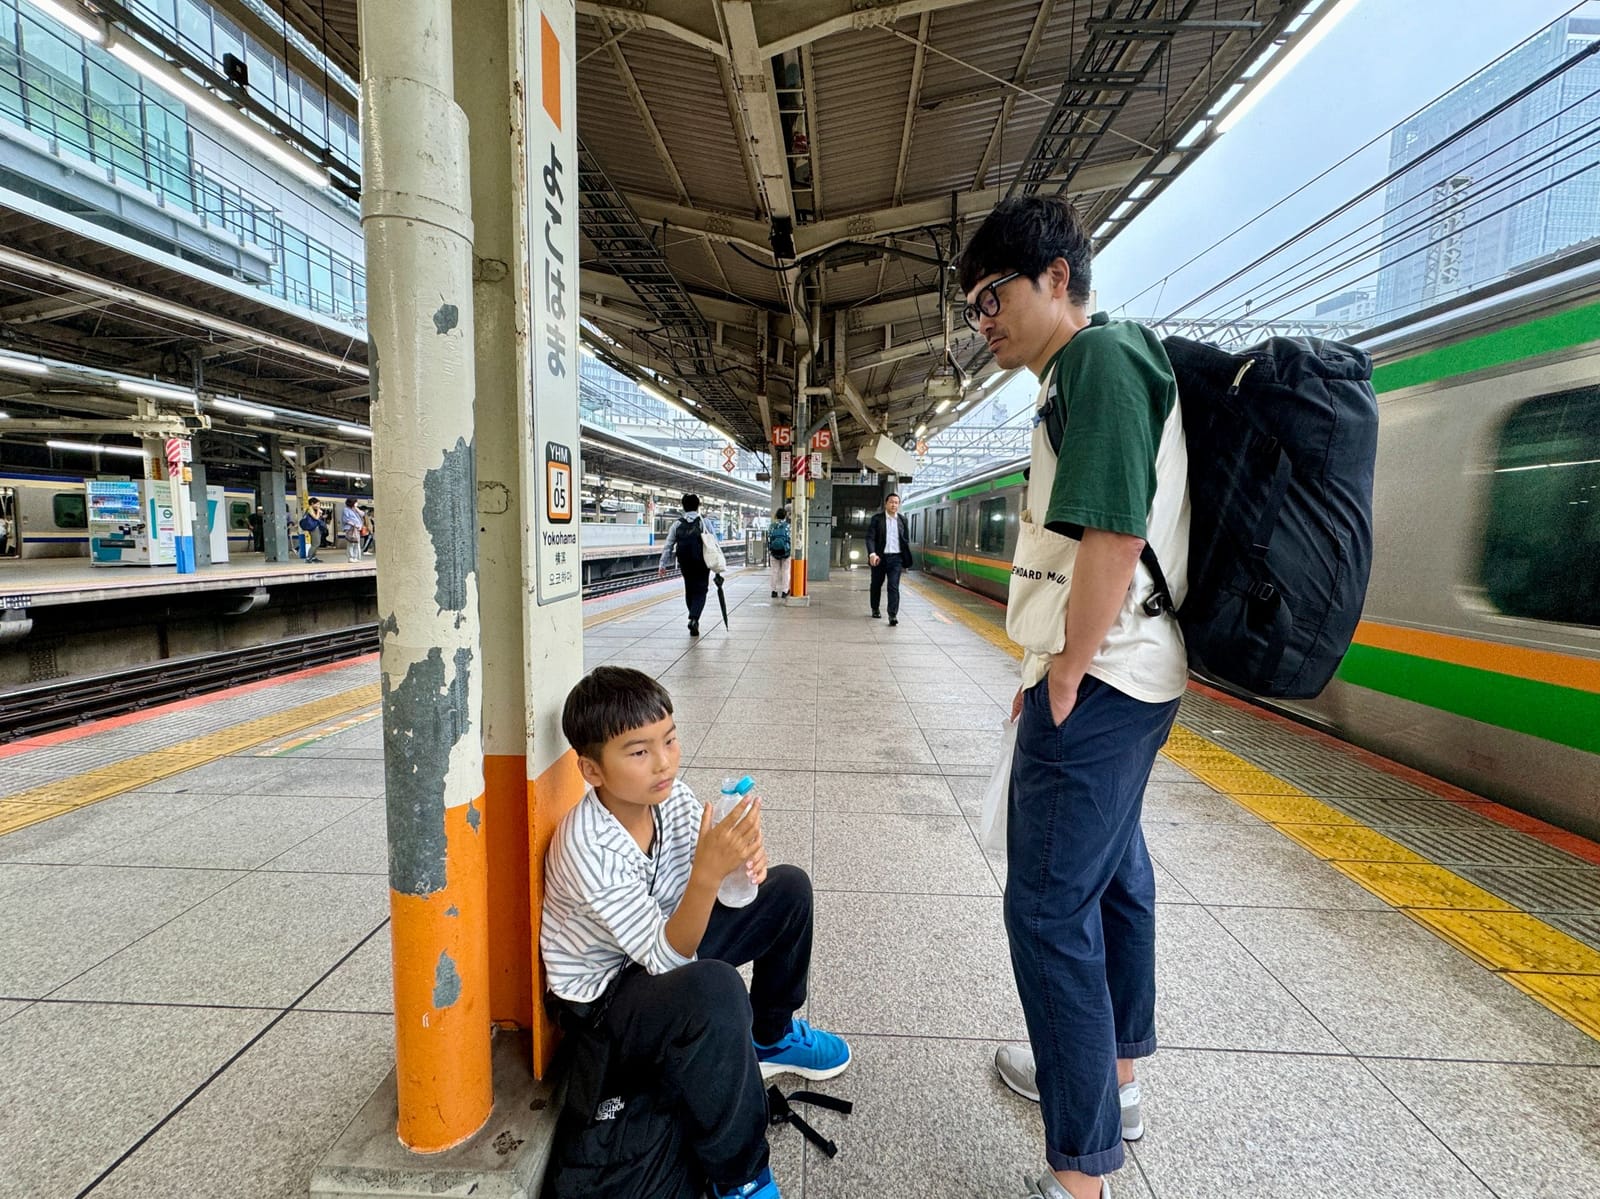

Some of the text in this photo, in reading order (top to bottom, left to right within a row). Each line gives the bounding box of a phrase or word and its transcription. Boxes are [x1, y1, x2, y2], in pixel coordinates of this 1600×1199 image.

[543, 142, 566, 379] よこはま
[773, 427, 790, 445] 15
[813, 431, 830, 448] 15
[550, 443, 568, 463] YHM
[555, 472, 563, 486] JT
[554, 488, 566, 508] 05
[542, 531, 576, 546] Yokohama
